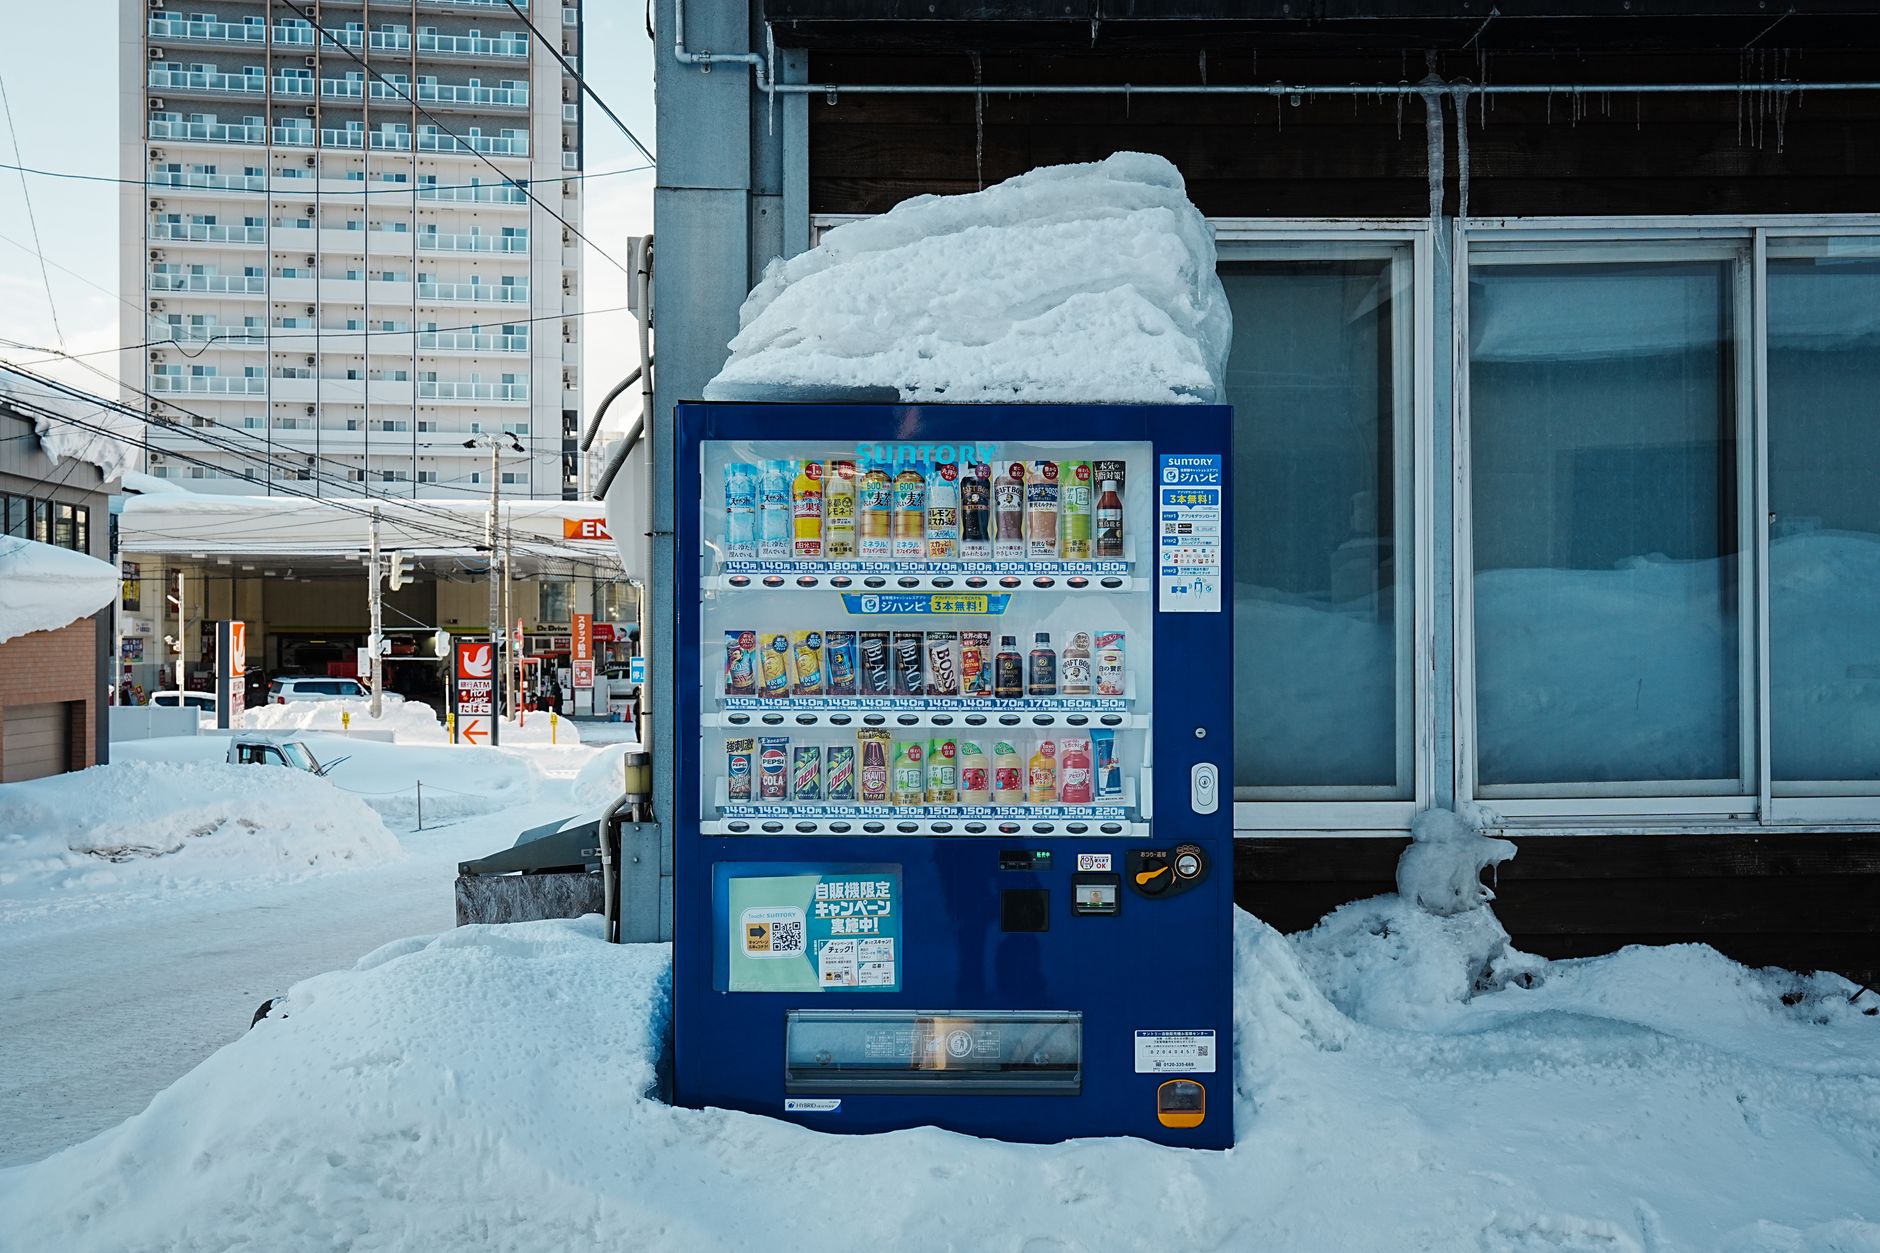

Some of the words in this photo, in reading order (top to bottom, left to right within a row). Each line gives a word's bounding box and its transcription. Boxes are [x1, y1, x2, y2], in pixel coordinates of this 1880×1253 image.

[855, 443, 996, 466] SUNTORY
[1180, 473, 1218, 482] ジハンピ
[1170, 494, 1212, 504] 3本無料!
[881, 601, 926, 612] ジハンピ
[934, 601, 982, 612] 3本無料!
[867, 644, 888, 692] BLACK
[901, 644, 922, 692] BLACK
[936, 648, 956, 690] BOSS
[471, 689, 487, 697] HOT
[460, 705, 489, 713] たばこ
[726, 738, 754, 753] 強刺激
[763, 776, 783, 785] COLA
[816, 881, 890, 899] 自販機限定
[816, 900, 890, 917] キャンペーン
[832, 917, 878, 933] 実施中!
